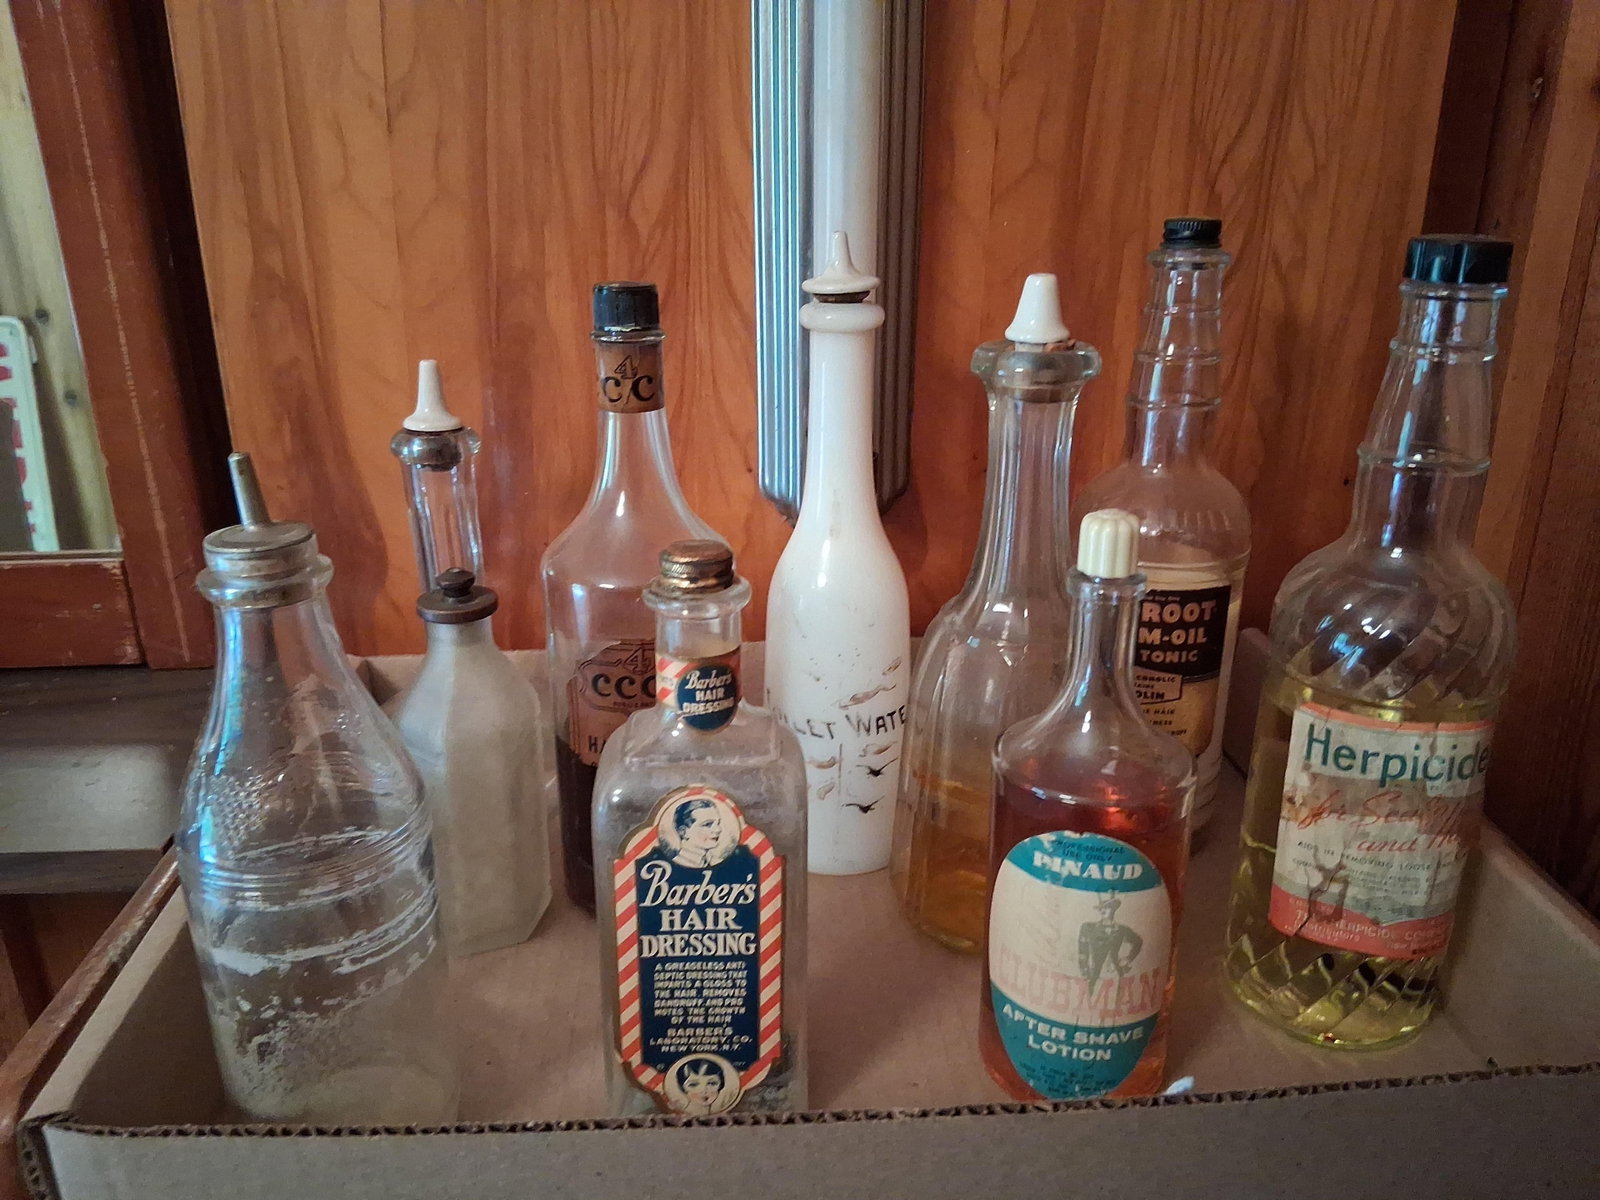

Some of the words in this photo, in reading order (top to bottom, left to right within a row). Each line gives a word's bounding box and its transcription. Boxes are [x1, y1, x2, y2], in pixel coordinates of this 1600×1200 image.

[614, 354, 637, 379] 4
[1141, 600, 1216, 624] ROOT
[1139, 650, 1199, 664] TONIC
[695, 687, 725, 702] HAIR
[1304, 723, 1489, 788] Herpicide
[1032, 849, 1143, 880] PINAUD
[639, 859, 757, 908] Barber's
[659, 907, 743, 932] HAIR
[639, 932, 757, 958] DRESSING
[654, 971, 685, 981] SEPTIC
[664, 962, 725, 971] GREASELESS
[654, 988, 671, 999] THE
[693, 980, 703, 988] A
[702, 979, 733, 988] GLOSS
[735, 979, 747, 988] TO
[687, 1007, 706, 1016] THE
[687, 1015, 706, 1024] THE
[1002, 1002, 1067, 1042] AFTER
[1073, 1026, 1144, 1047] SHAVE
[1027, 1034, 1113, 1062] LOTION
